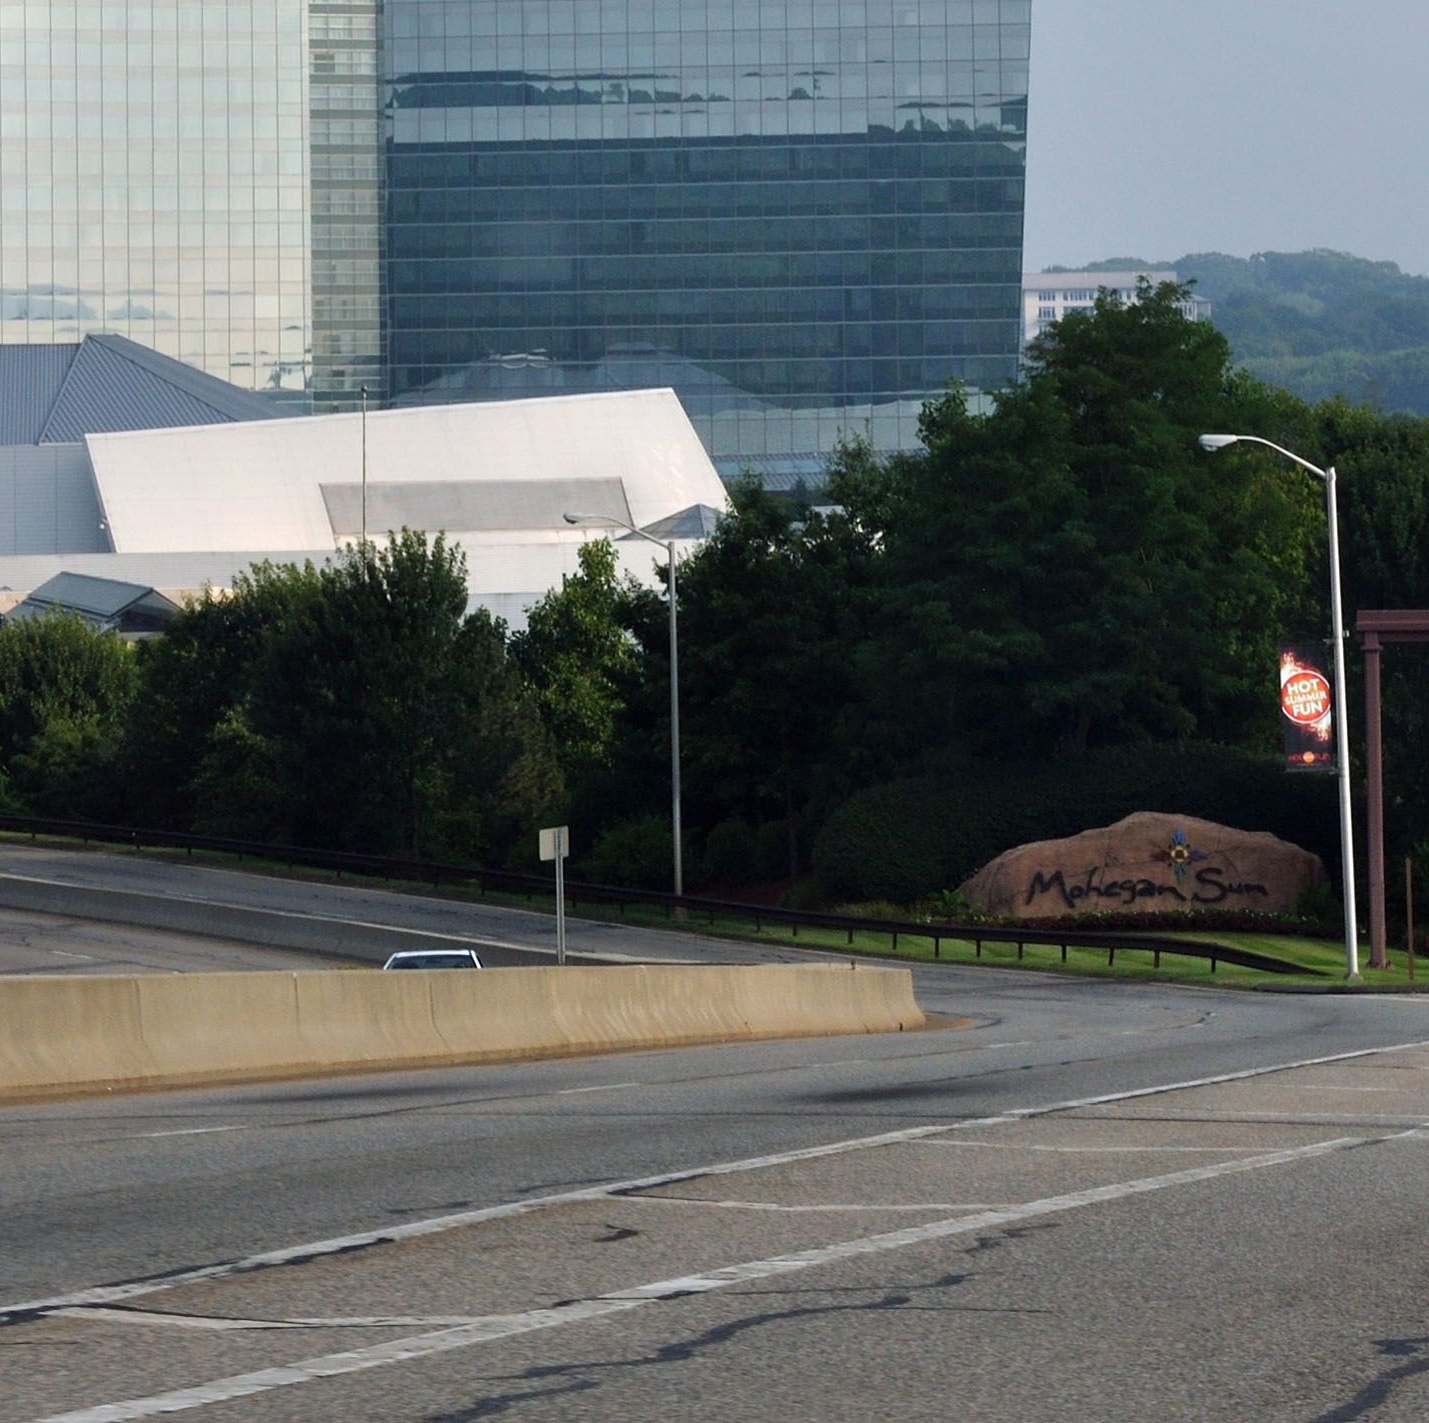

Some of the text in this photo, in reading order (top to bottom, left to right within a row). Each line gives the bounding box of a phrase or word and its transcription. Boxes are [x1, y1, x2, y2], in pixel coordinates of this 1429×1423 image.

[1286, 678, 1320, 695] HOT
[1284, 690, 1327, 705] SUMMER
[1292, 701, 1323, 717] FUN
[1025, 866, 1268, 909] Mohegan Sun
